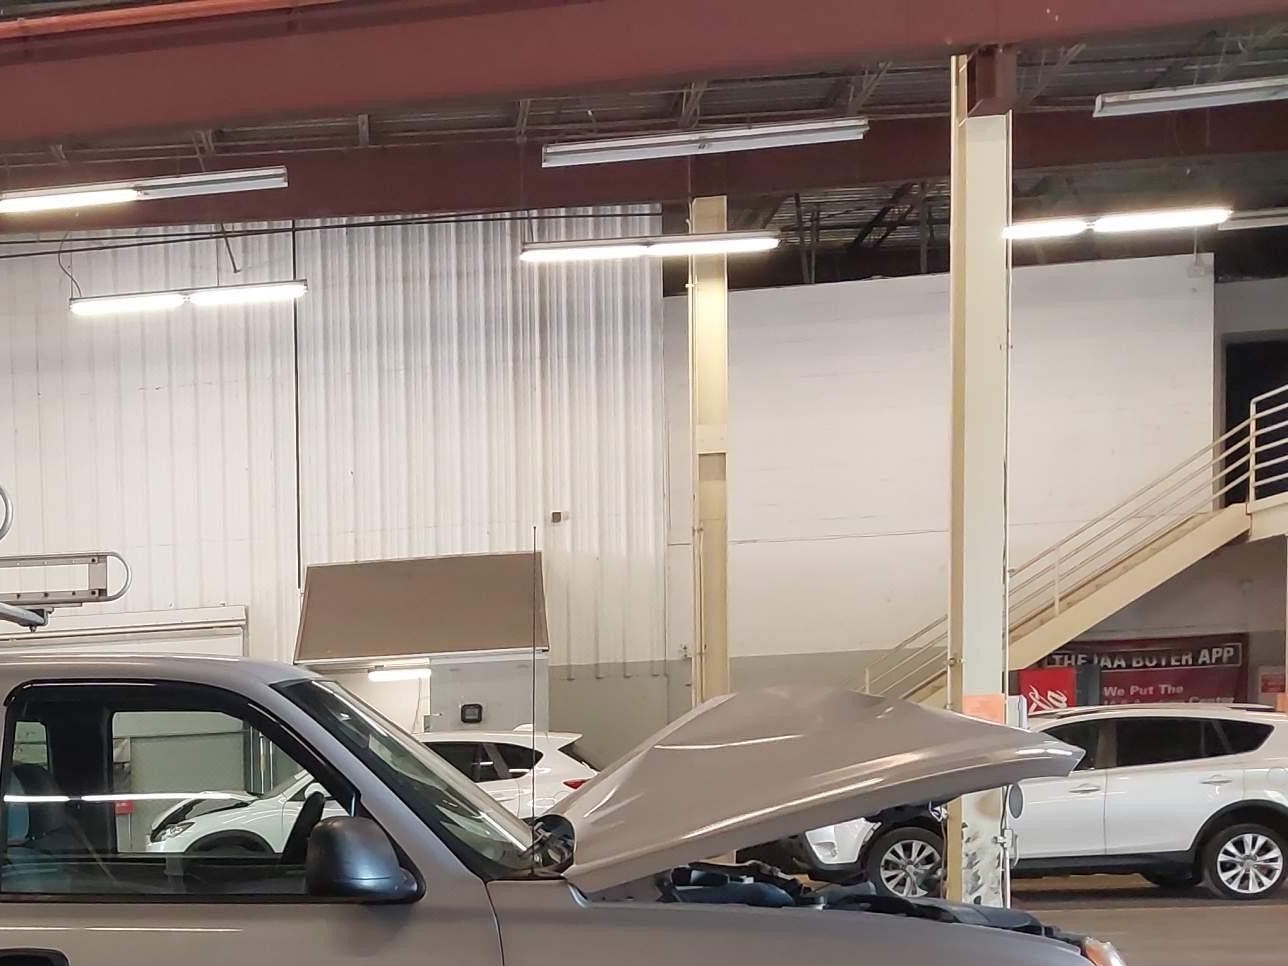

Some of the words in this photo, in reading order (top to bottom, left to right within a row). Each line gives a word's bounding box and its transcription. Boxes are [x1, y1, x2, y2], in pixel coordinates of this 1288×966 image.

[1198, 647, 1234, 665] APP
[1103, 686, 1125, 697] We
[1130, 684, 1154, 696] Put
[1158, 684, 1184, 695] The
